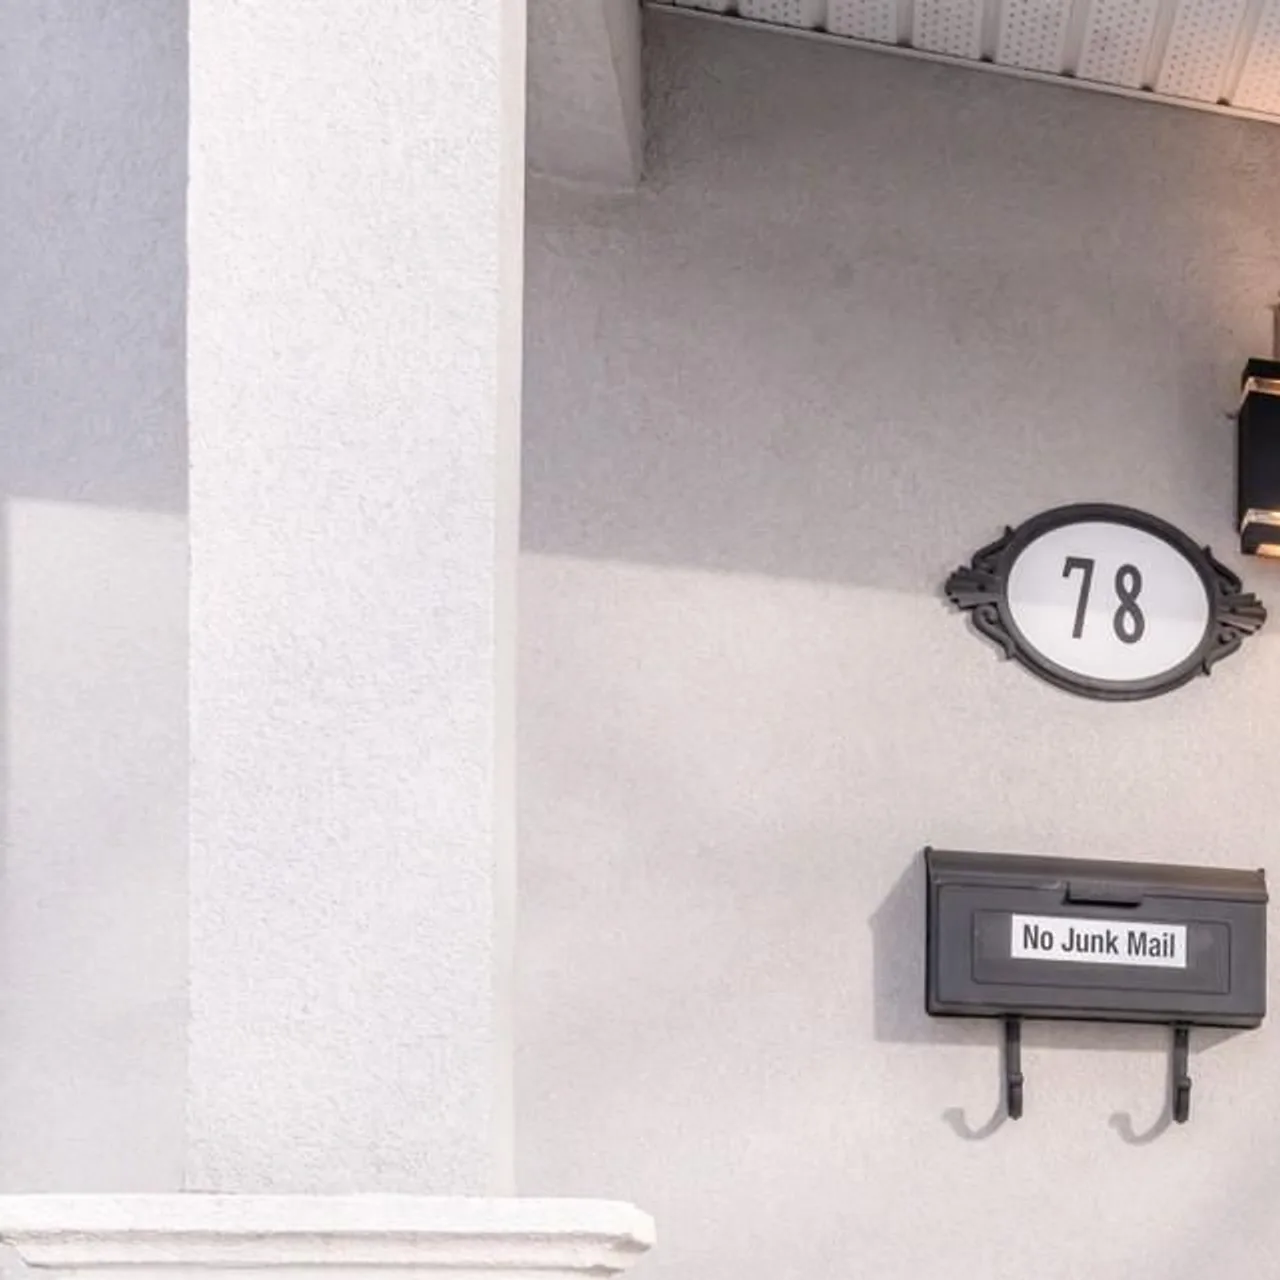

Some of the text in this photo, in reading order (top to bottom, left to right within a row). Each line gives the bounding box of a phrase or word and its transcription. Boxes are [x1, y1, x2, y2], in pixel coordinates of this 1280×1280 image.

[1061, 556, 1145, 644] 78
[1023, 924, 1175, 958] No Junk Mail
